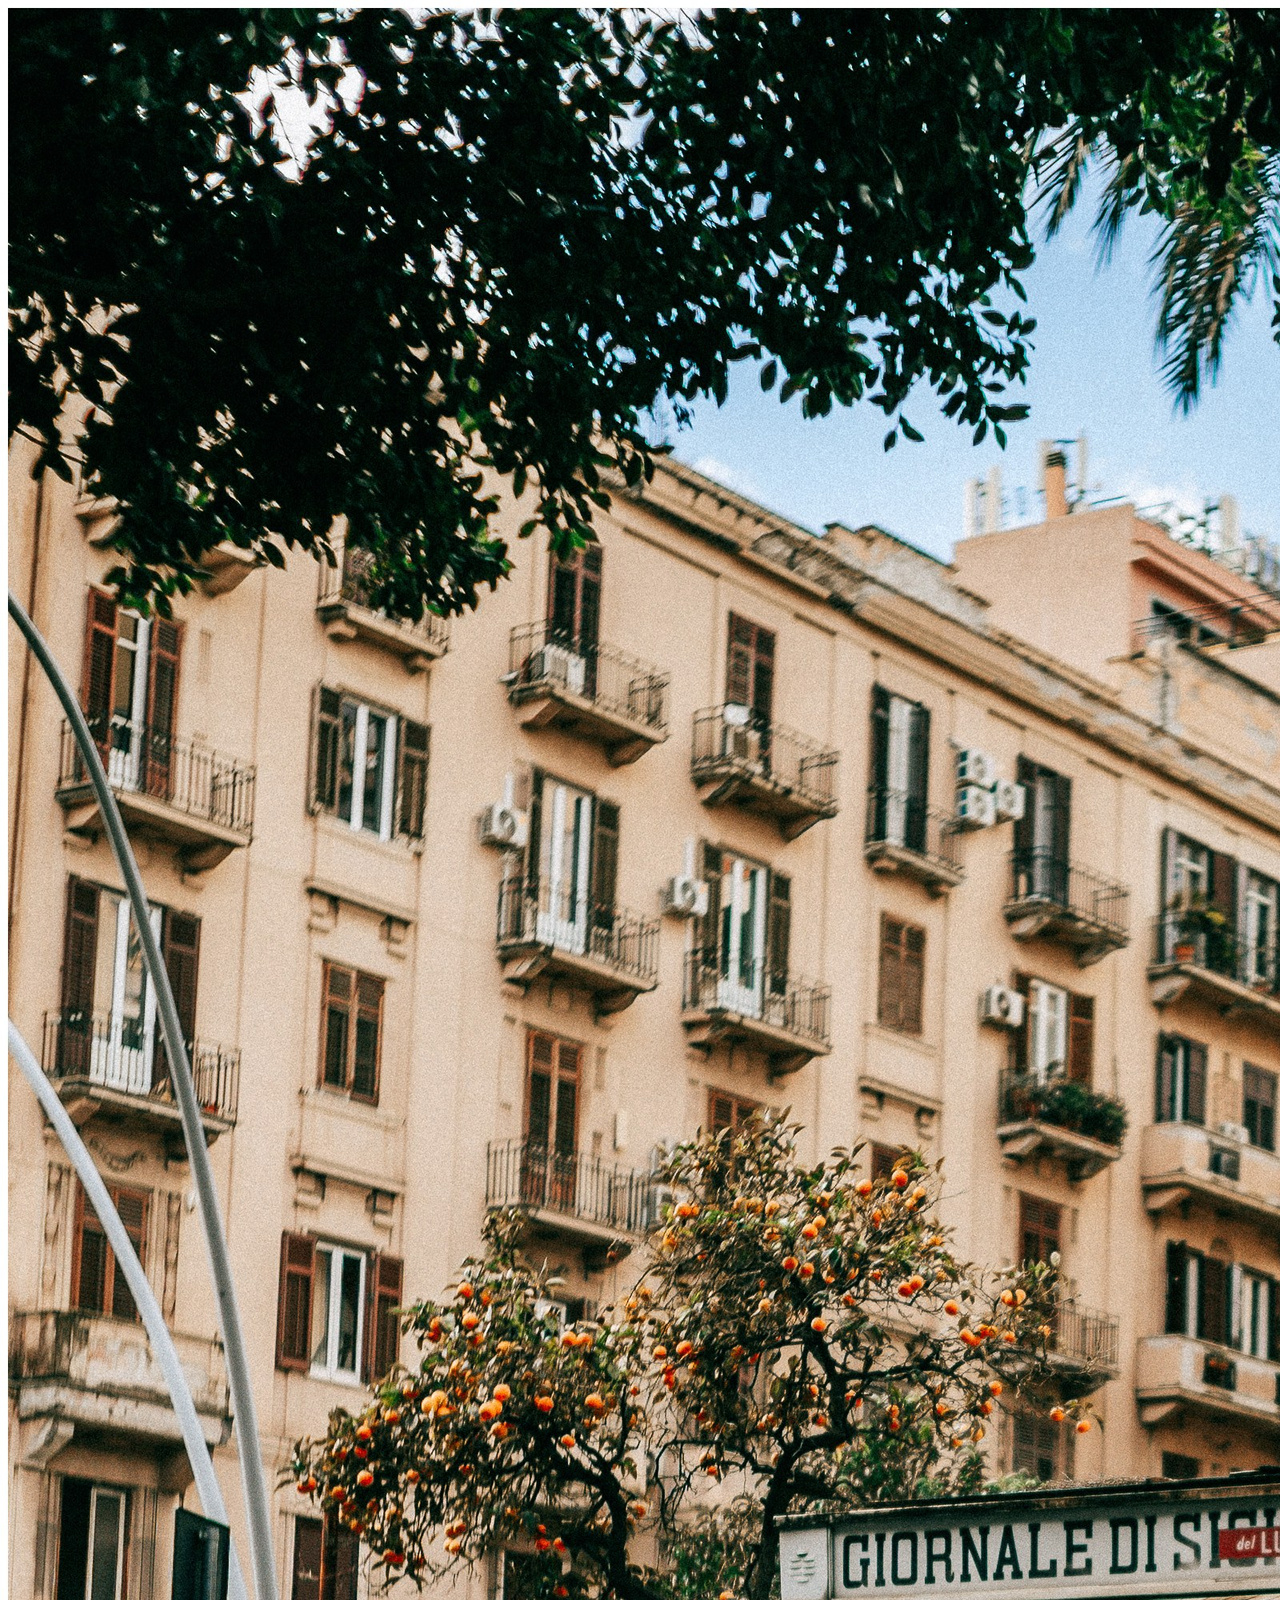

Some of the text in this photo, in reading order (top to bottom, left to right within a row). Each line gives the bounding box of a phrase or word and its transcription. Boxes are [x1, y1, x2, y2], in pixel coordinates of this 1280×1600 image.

[843, 1519, 1093, 1589] GIORNALE
[1109, 1513, 1157, 1575] DI
[1236, 1535, 1255, 1551] del
